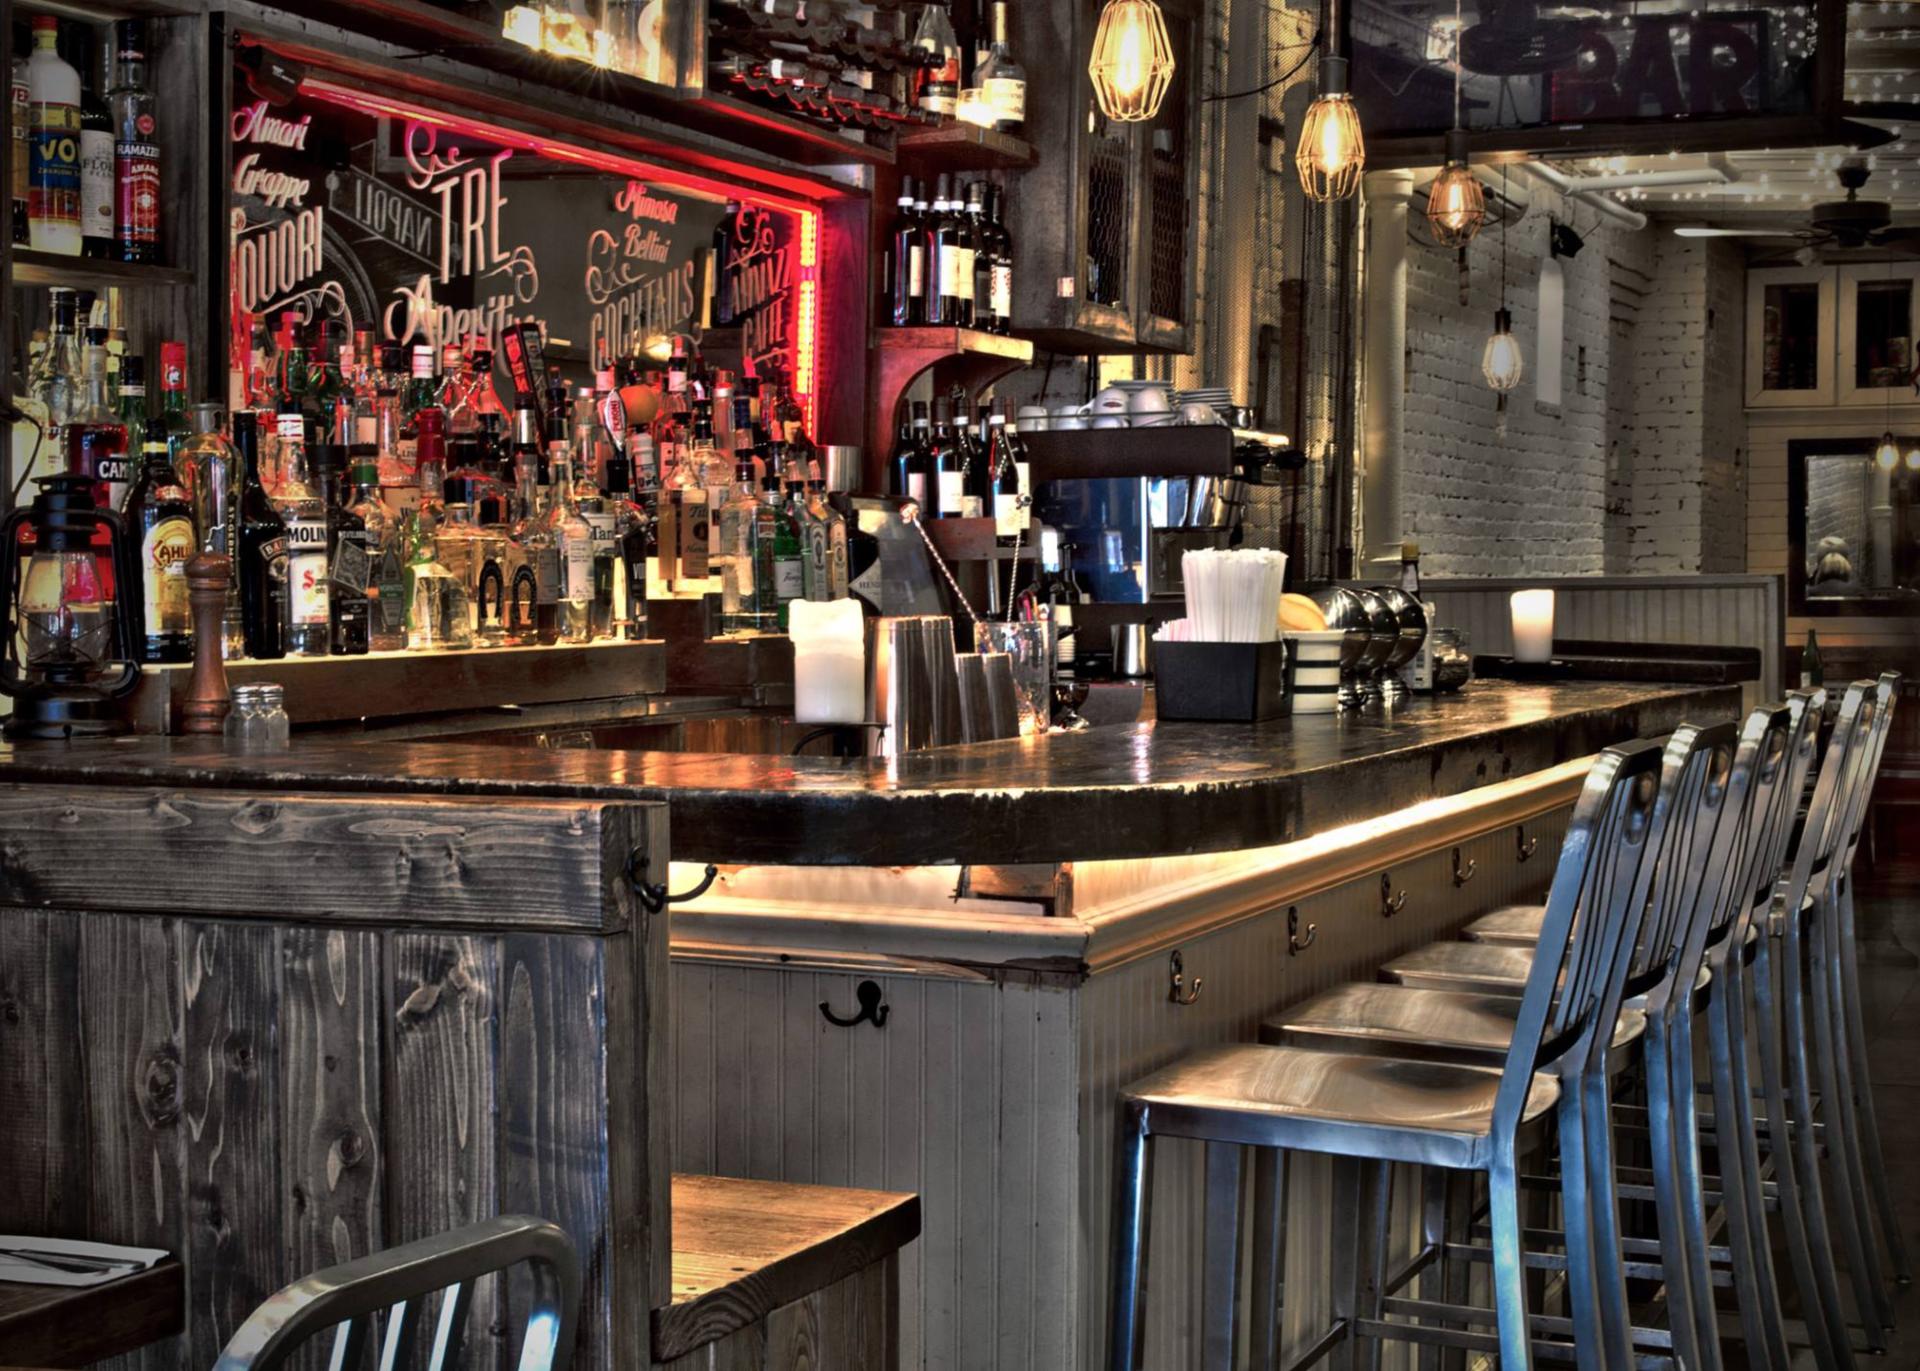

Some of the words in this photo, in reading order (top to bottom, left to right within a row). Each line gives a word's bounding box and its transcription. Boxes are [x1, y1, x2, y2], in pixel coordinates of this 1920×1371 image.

[1557, 22, 1759, 119] BAR
[38, 137, 80, 163] VO
[231, 101, 312, 150] Amari
[233, 153, 311, 208] Grappe
[615, 181, 679, 225] Mimosa
[431, 148, 513, 285] TRE
[624, 223, 671, 264] Bellini
[590, 260, 695, 374] COCKTAILS
[610, 400, 622, 432] PERONI
